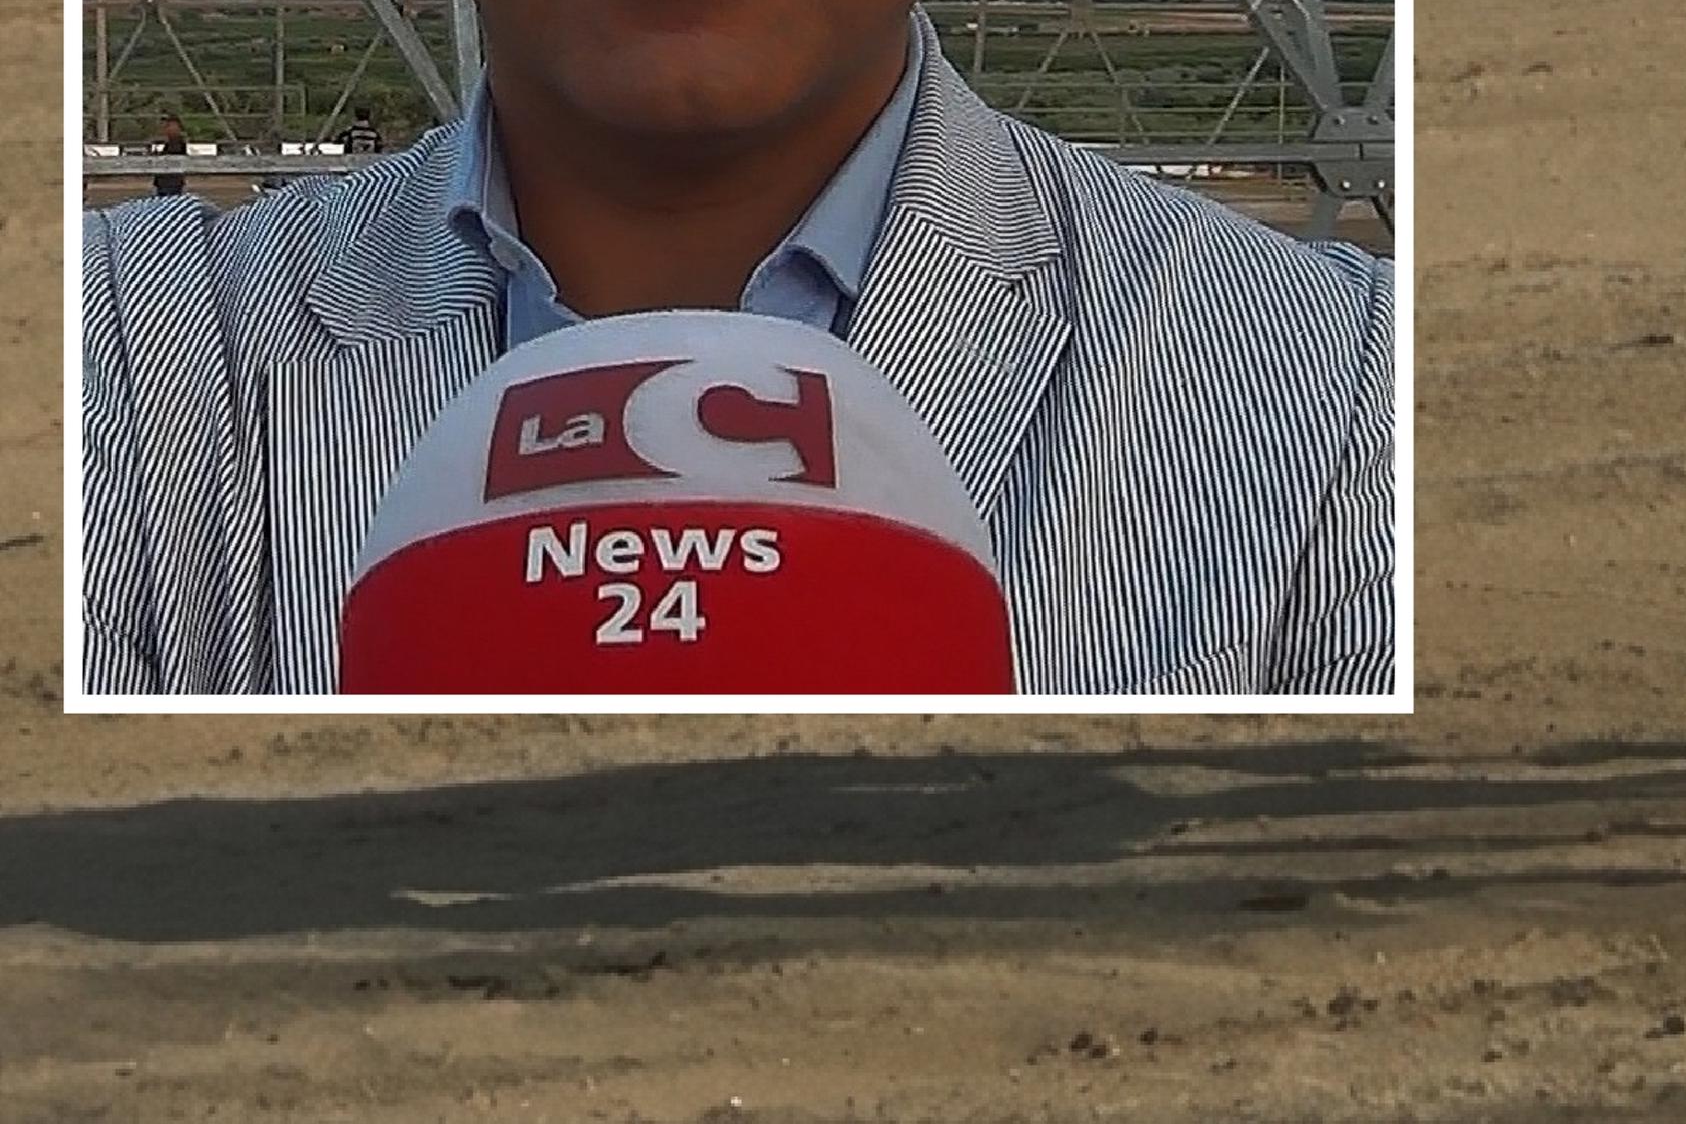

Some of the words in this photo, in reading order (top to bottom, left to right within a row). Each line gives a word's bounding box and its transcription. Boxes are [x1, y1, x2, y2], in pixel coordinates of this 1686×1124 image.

[517, 409, 603, 456] La
[523, 519, 782, 583] News
[594, 579, 707, 646] 24
